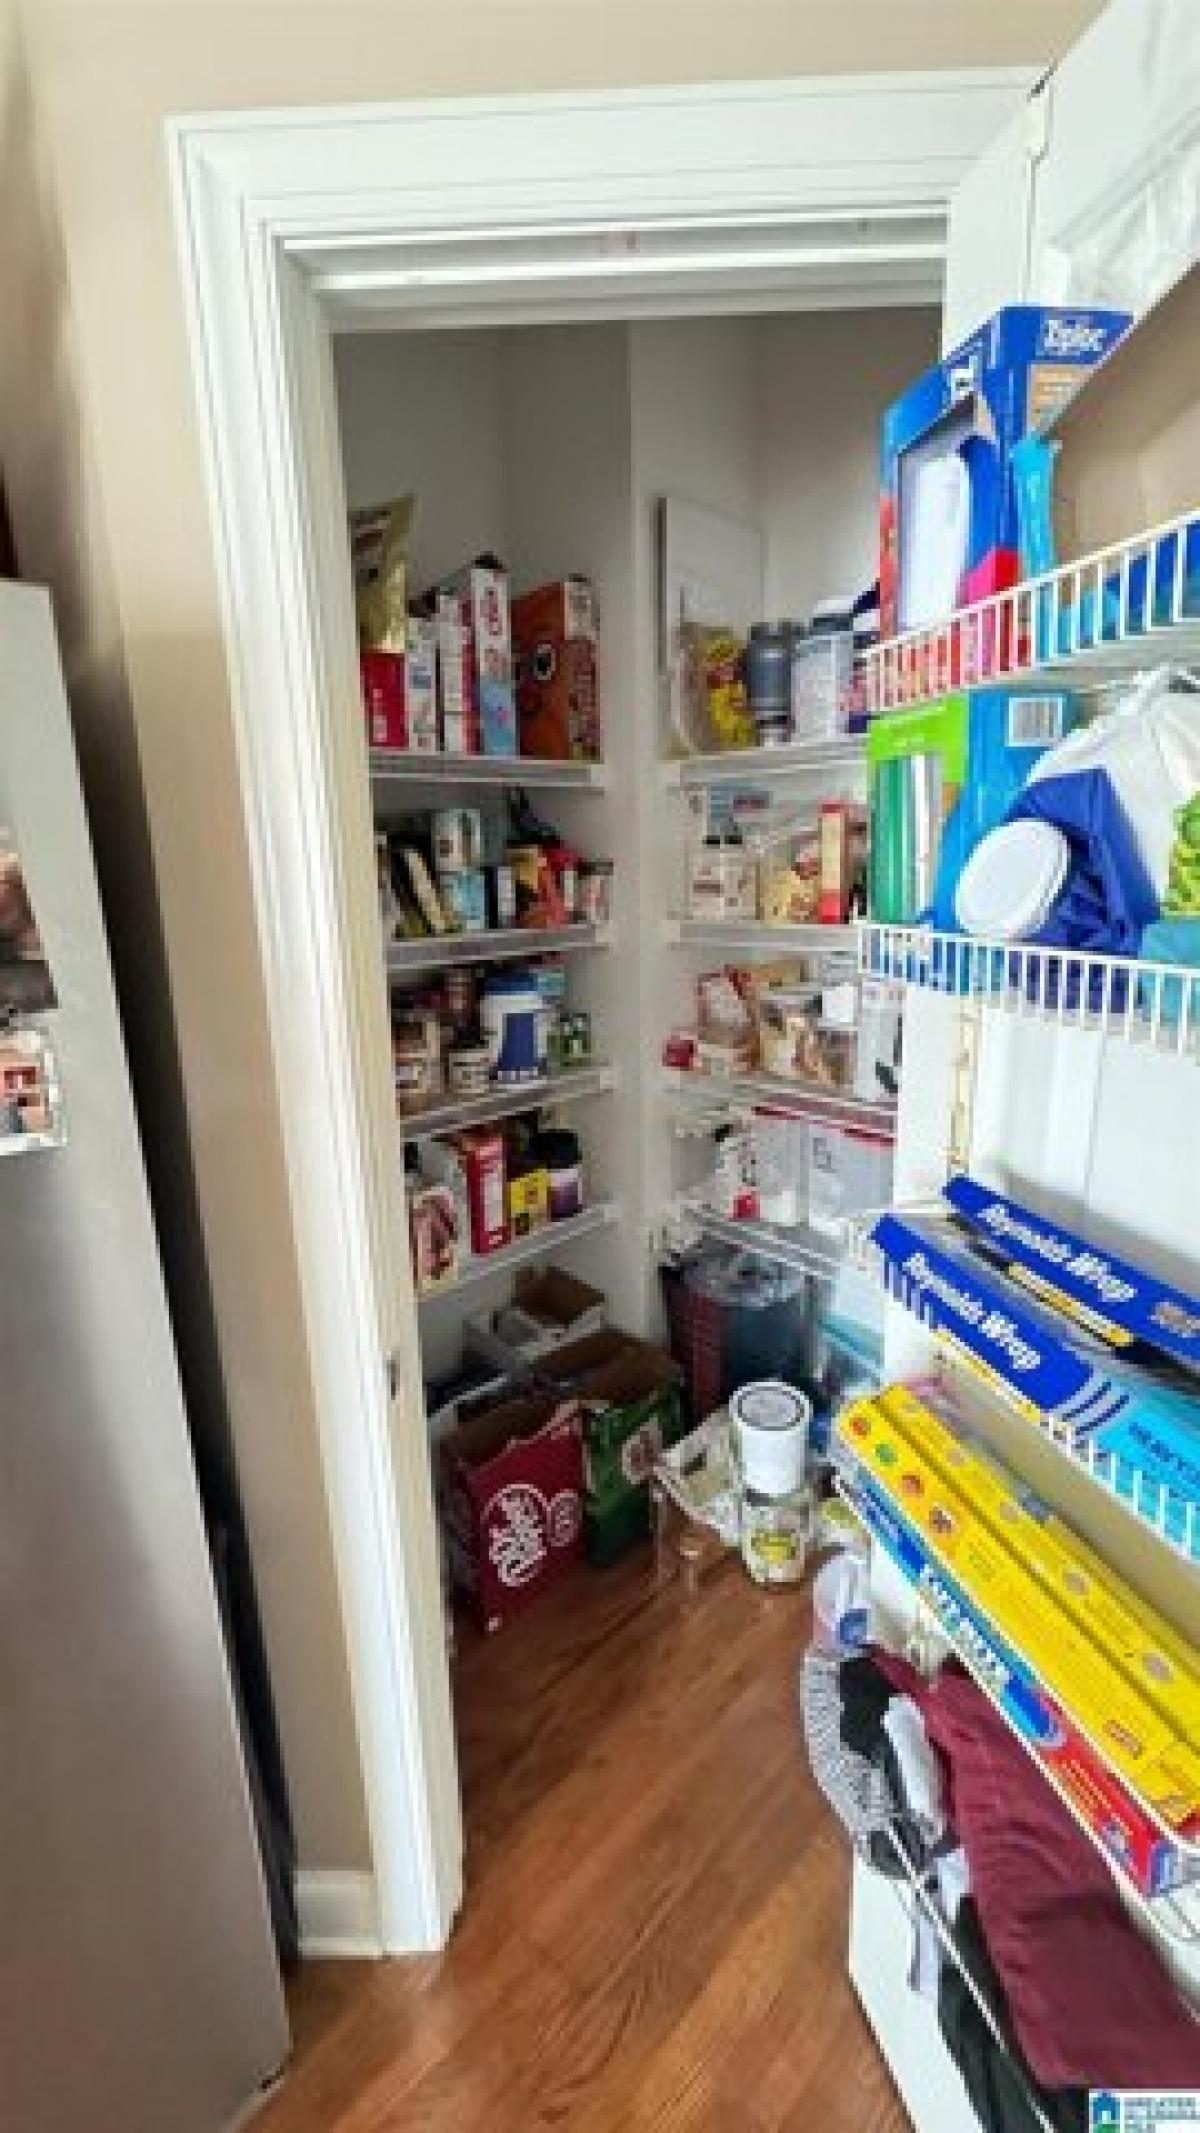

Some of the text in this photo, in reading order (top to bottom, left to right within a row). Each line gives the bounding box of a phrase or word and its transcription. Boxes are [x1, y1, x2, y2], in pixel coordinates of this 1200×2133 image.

[977, 1202, 1073, 1263] Reynolds
[1065, 1251, 1137, 1304] Wrap
[902, 1252, 985, 1325] Reynolds
[978, 1311, 1042, 1371] Wrap
